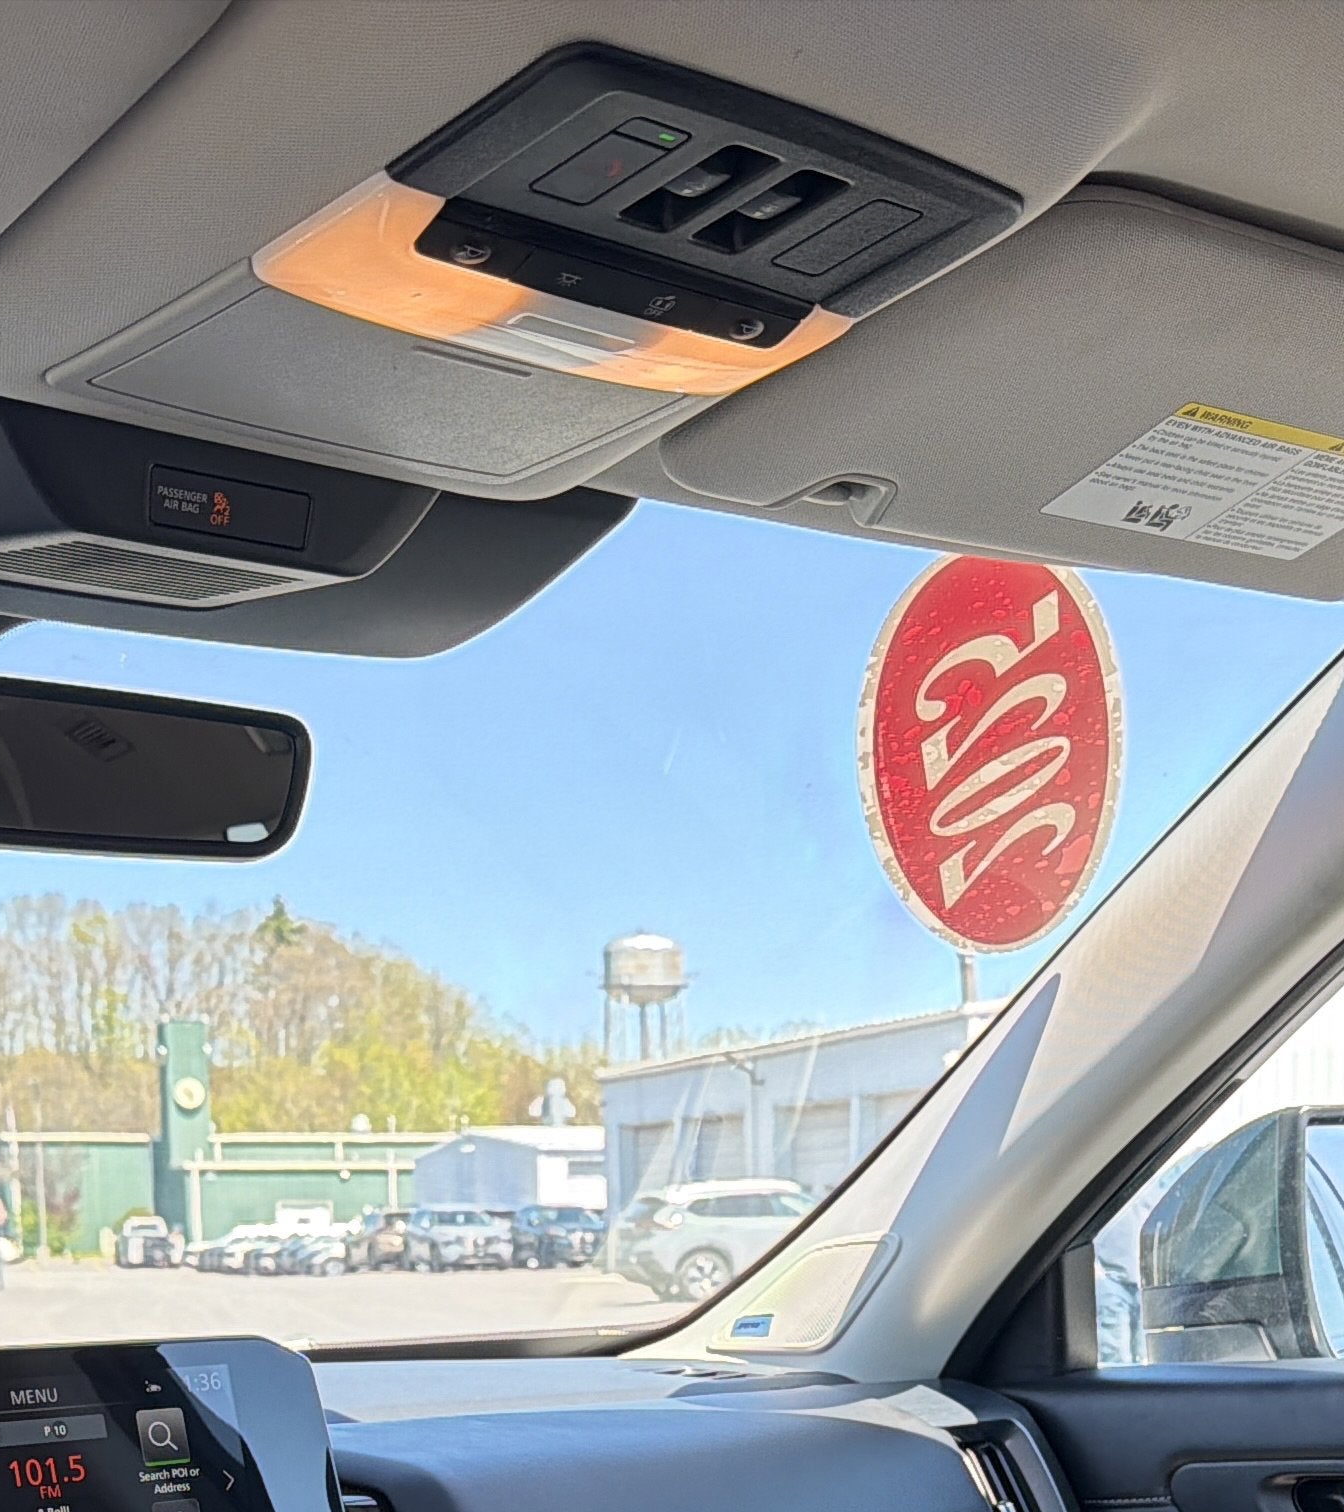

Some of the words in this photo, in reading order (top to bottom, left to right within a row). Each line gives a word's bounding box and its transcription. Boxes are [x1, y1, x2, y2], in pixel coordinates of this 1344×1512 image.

[1195, 410, 1257, 429] WARNING
[1162, 418, 1194, 430] EVEN
[1187, 424, 1218, 435] WITH
[1210, 430, 1264, 446] ADVANCED
[1257, 441, 1280, 450] AIR
[1273, 445, 1304, 455] BAGS
[157, 485, 208, 504] PASSENGER
[163, 499, 180, 511] AIR
[181, 502, 200, 514] BAG
[209, 513, 230, 526] OFF
[10, 1387, 58, 1406] MENU
[44, 1425, 51, 1436] P
[53, 1424, 67, 1435] 10
[8, 1453, 88, 1488] 101.5
[138, 1469, 171, 1483] Search
[171, 1468, 187, 1479] POI
[189, 1468, 200, 1477] or
[39, 1484, 62, 1500] FM
[153, 1481, 191, 1495] Address
